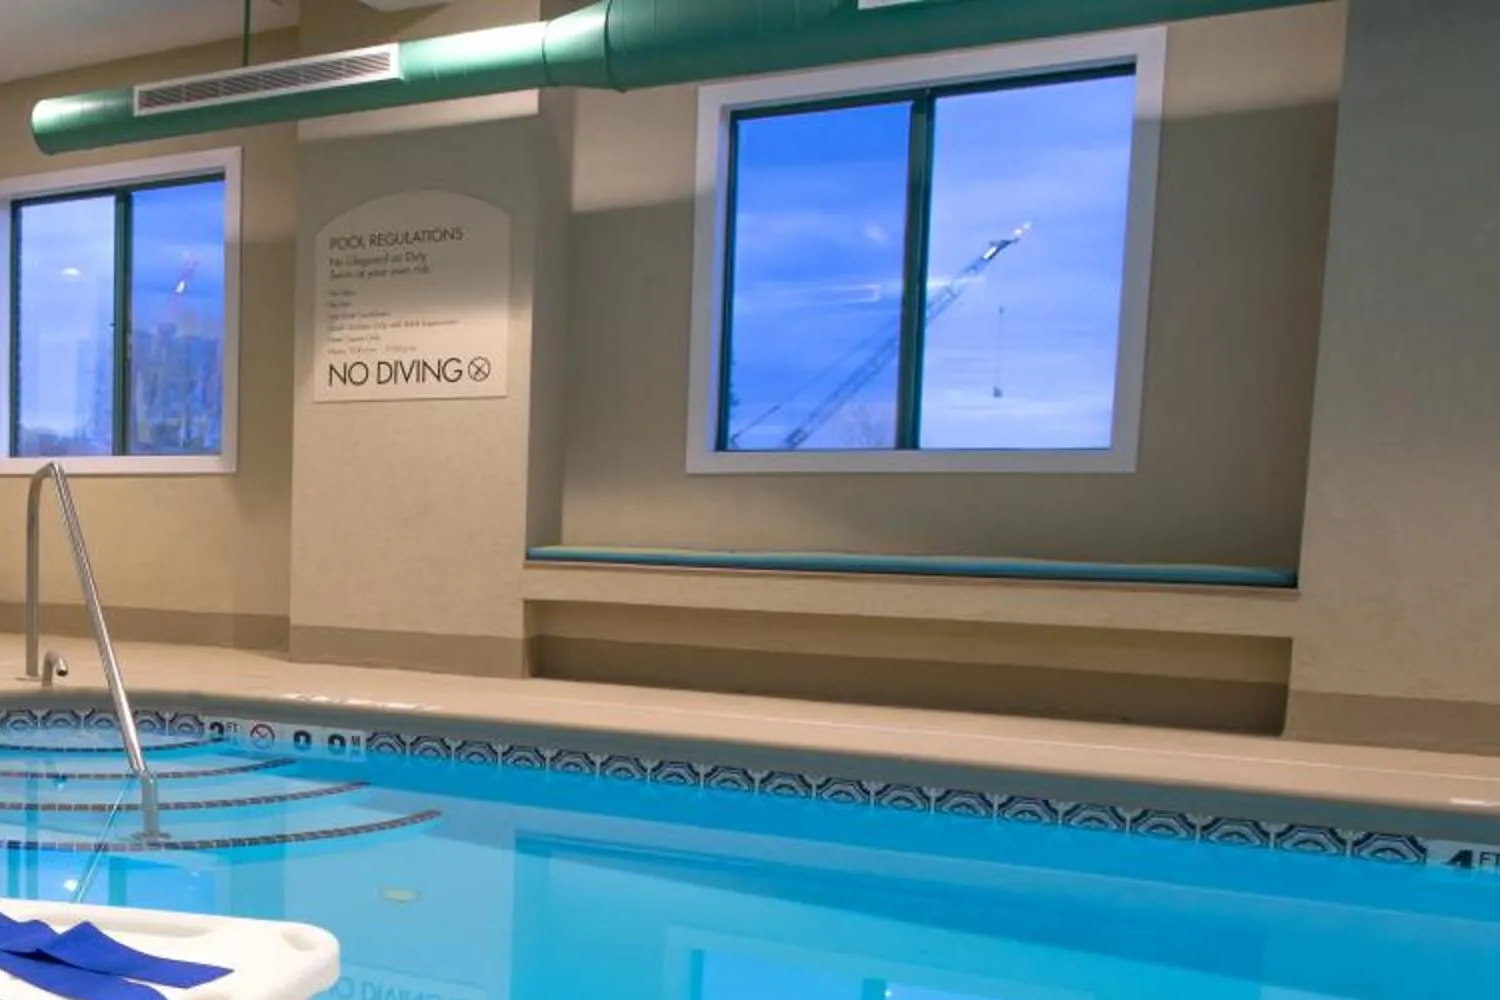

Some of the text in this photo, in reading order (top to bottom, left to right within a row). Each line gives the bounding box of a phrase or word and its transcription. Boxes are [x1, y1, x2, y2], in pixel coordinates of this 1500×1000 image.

[329, 227, 464, 250] POOL REGULATIONS
[329, 357, 463, 387] NO DIVING
